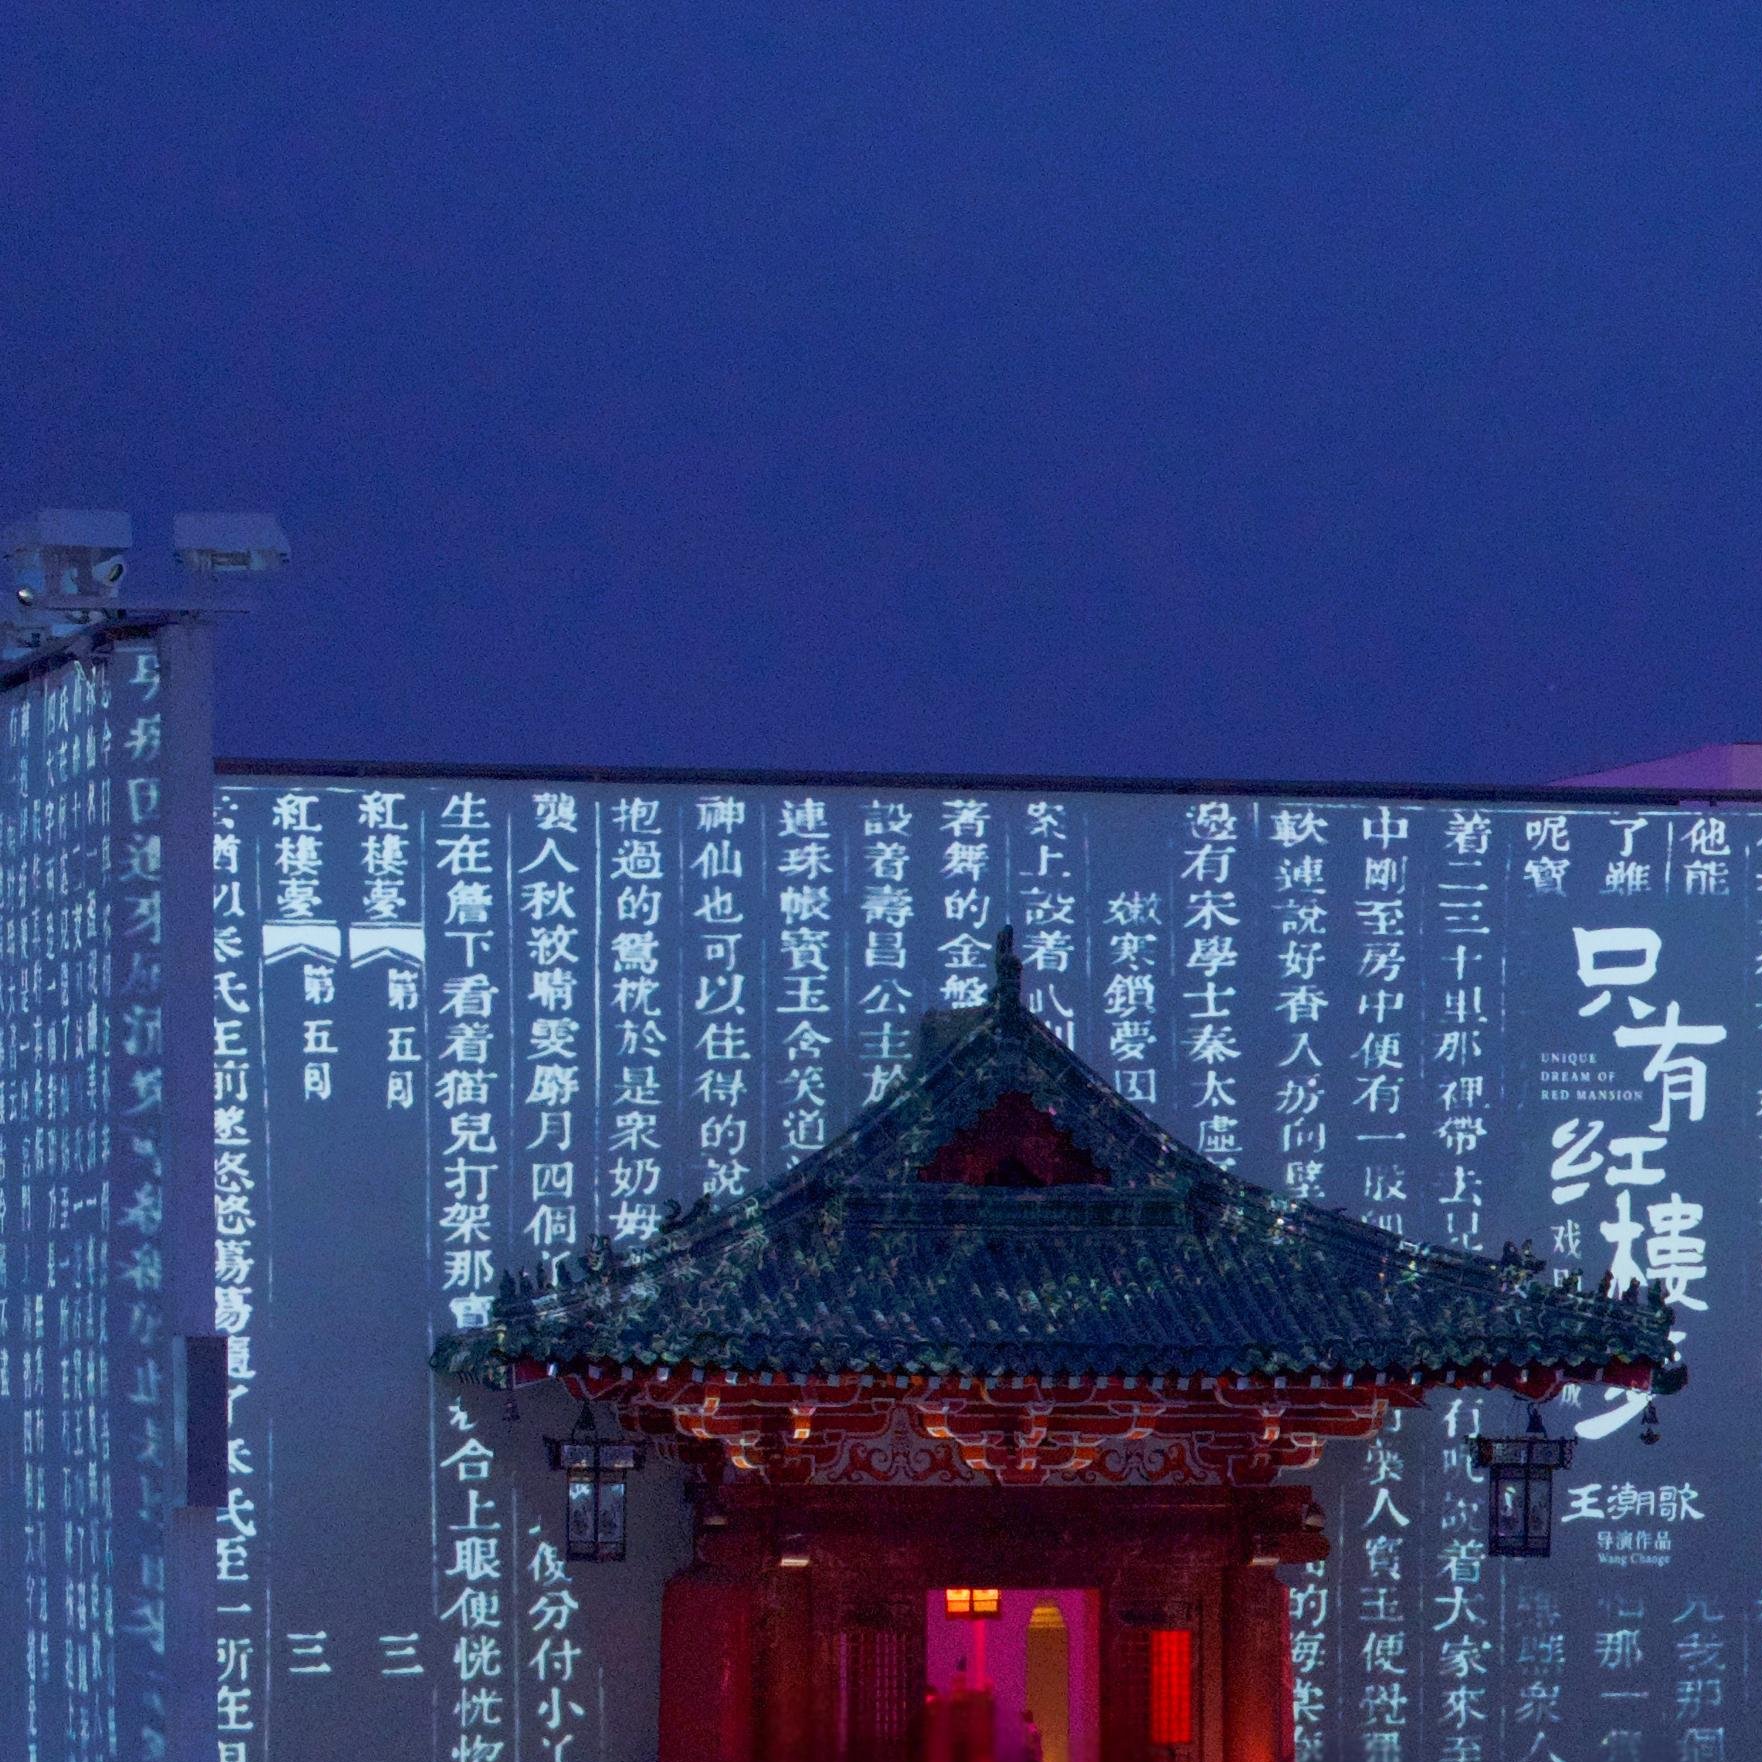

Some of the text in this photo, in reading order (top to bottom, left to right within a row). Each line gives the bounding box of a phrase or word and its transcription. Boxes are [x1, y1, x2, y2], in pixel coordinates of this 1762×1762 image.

[272, 792, 322, 918] 紅樓夢
[358, 790, 408, 918] 紅樓夢
[1541, 1071, 1590, 1083] DREAM
[1541, 1089, 1569, 1101] RED
[1562, 1482, 1705, 1523] 王潮歌
[1598, 1531, 1672, 1552] 导演作品
[287, 1631, 331, 1675] 三
[378, 1632, 425, 1676] 三
